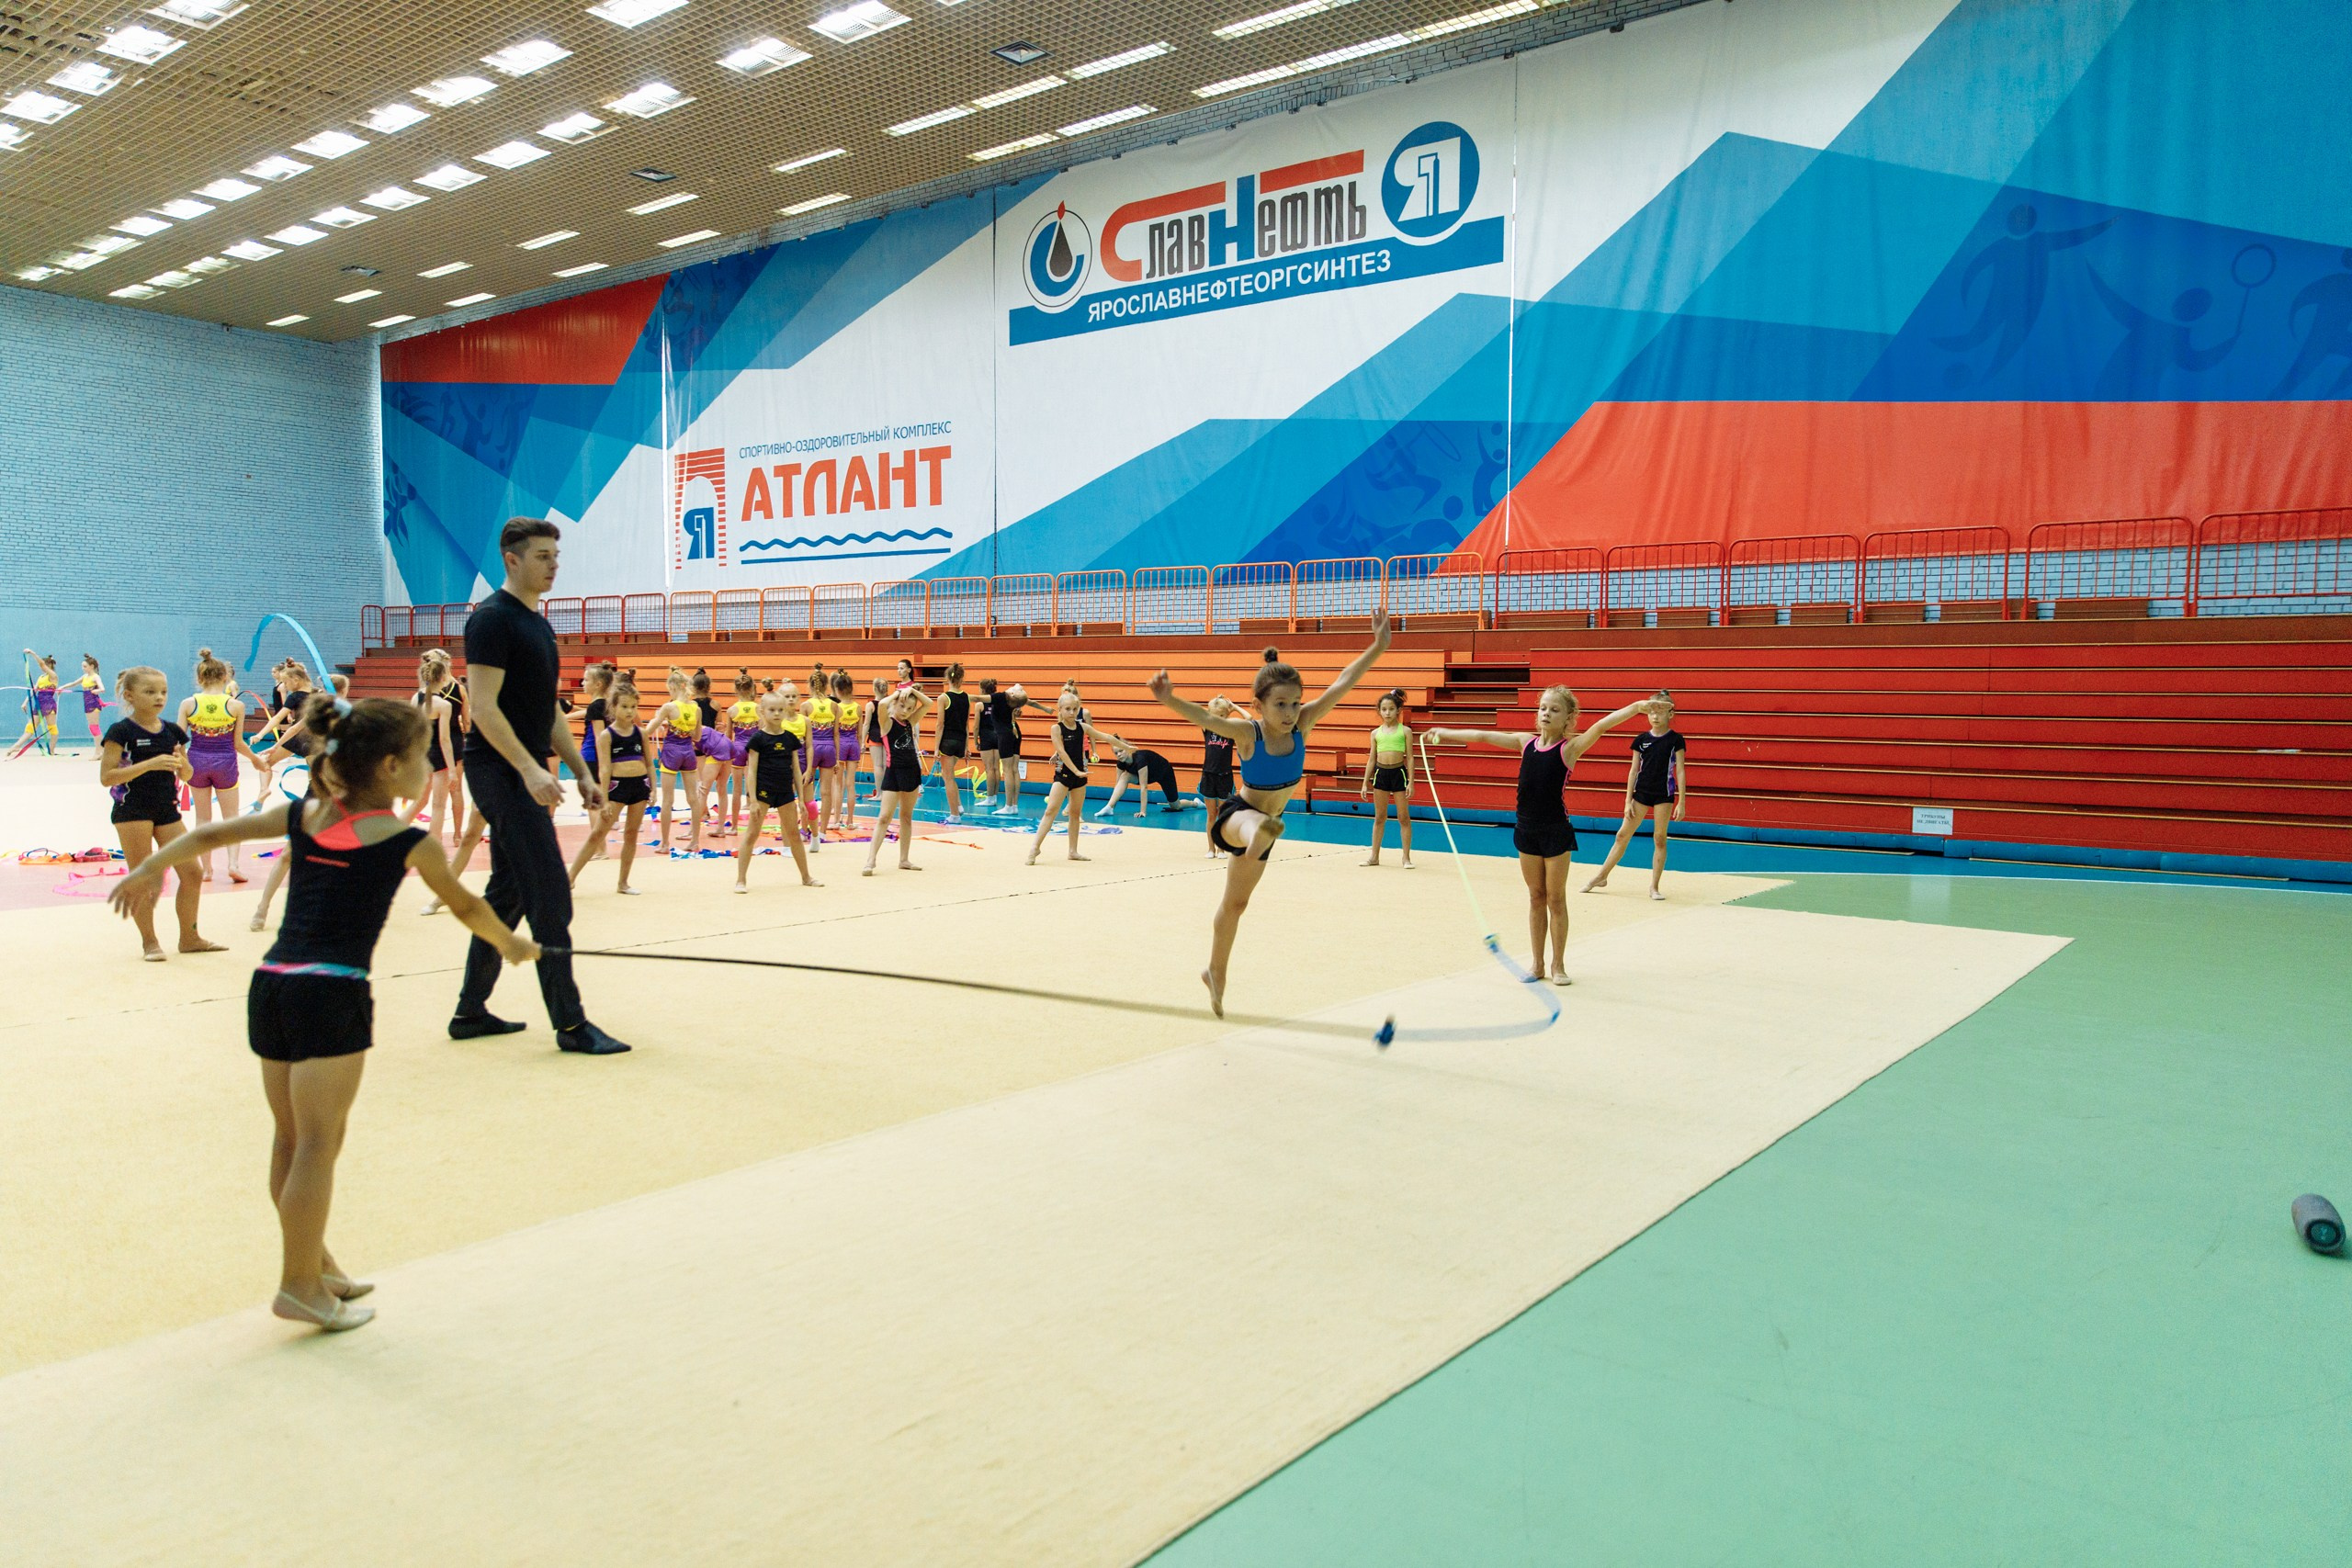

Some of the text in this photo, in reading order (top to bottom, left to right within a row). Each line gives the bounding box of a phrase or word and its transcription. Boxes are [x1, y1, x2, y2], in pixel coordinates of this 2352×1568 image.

[1088, 249, 1391, 322] ЯРОСЛАВНЕФТЕОРГСИНТЕЗ
[739, 421, 952, 459] СПОРТИВНО-ОЗДОРОВИТЕЛЬНЫЙ КОМПЛЕКС
[741, 445, 952, 522] АТЛАНТ
